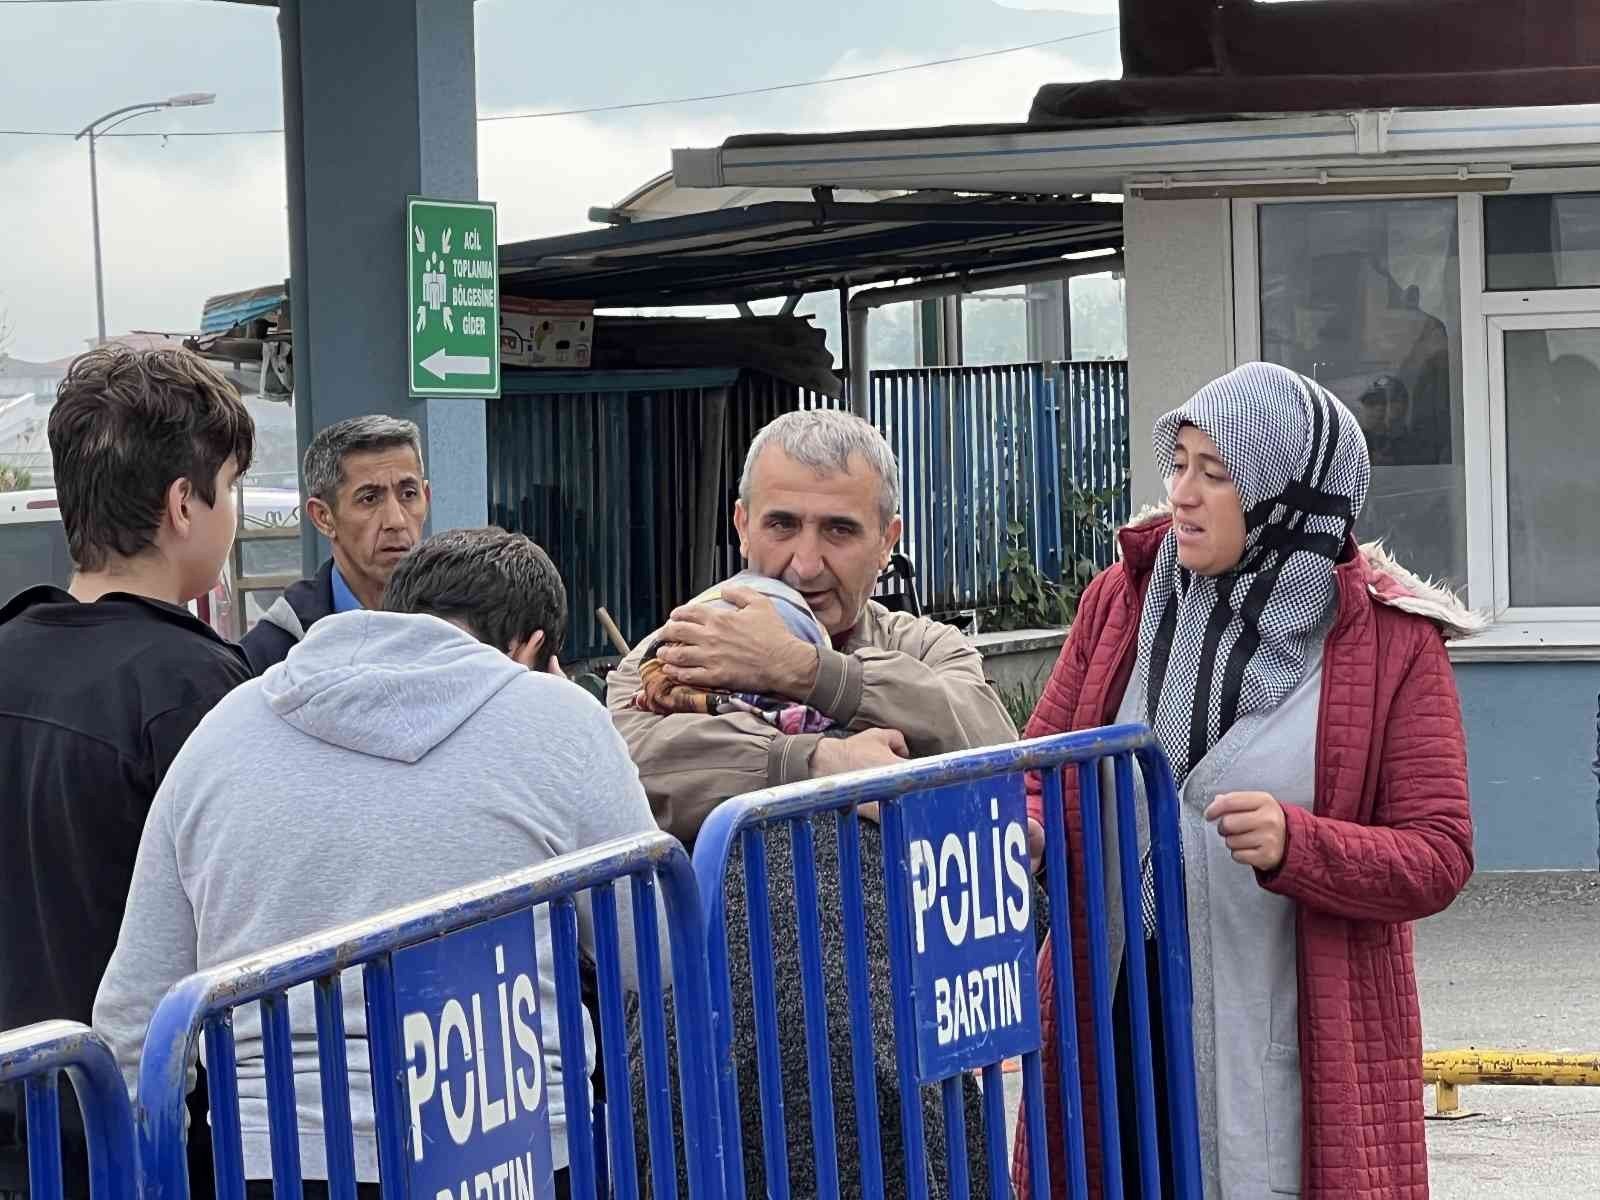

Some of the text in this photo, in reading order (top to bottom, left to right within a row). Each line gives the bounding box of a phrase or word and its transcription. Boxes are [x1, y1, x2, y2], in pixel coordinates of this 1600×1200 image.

[464, 228, 482, 250] ACİL
[453, 259, 493, 279] TOPLANMA
[453, 284, 494, 307] BÖLGESİNE
[462, 312, 486, 336] GİDER
[910, 798, 1030, 953] POLİS
[935, 960, 1022, 1045] BARTIN
[403, 945, 541, 1161] POLİS
